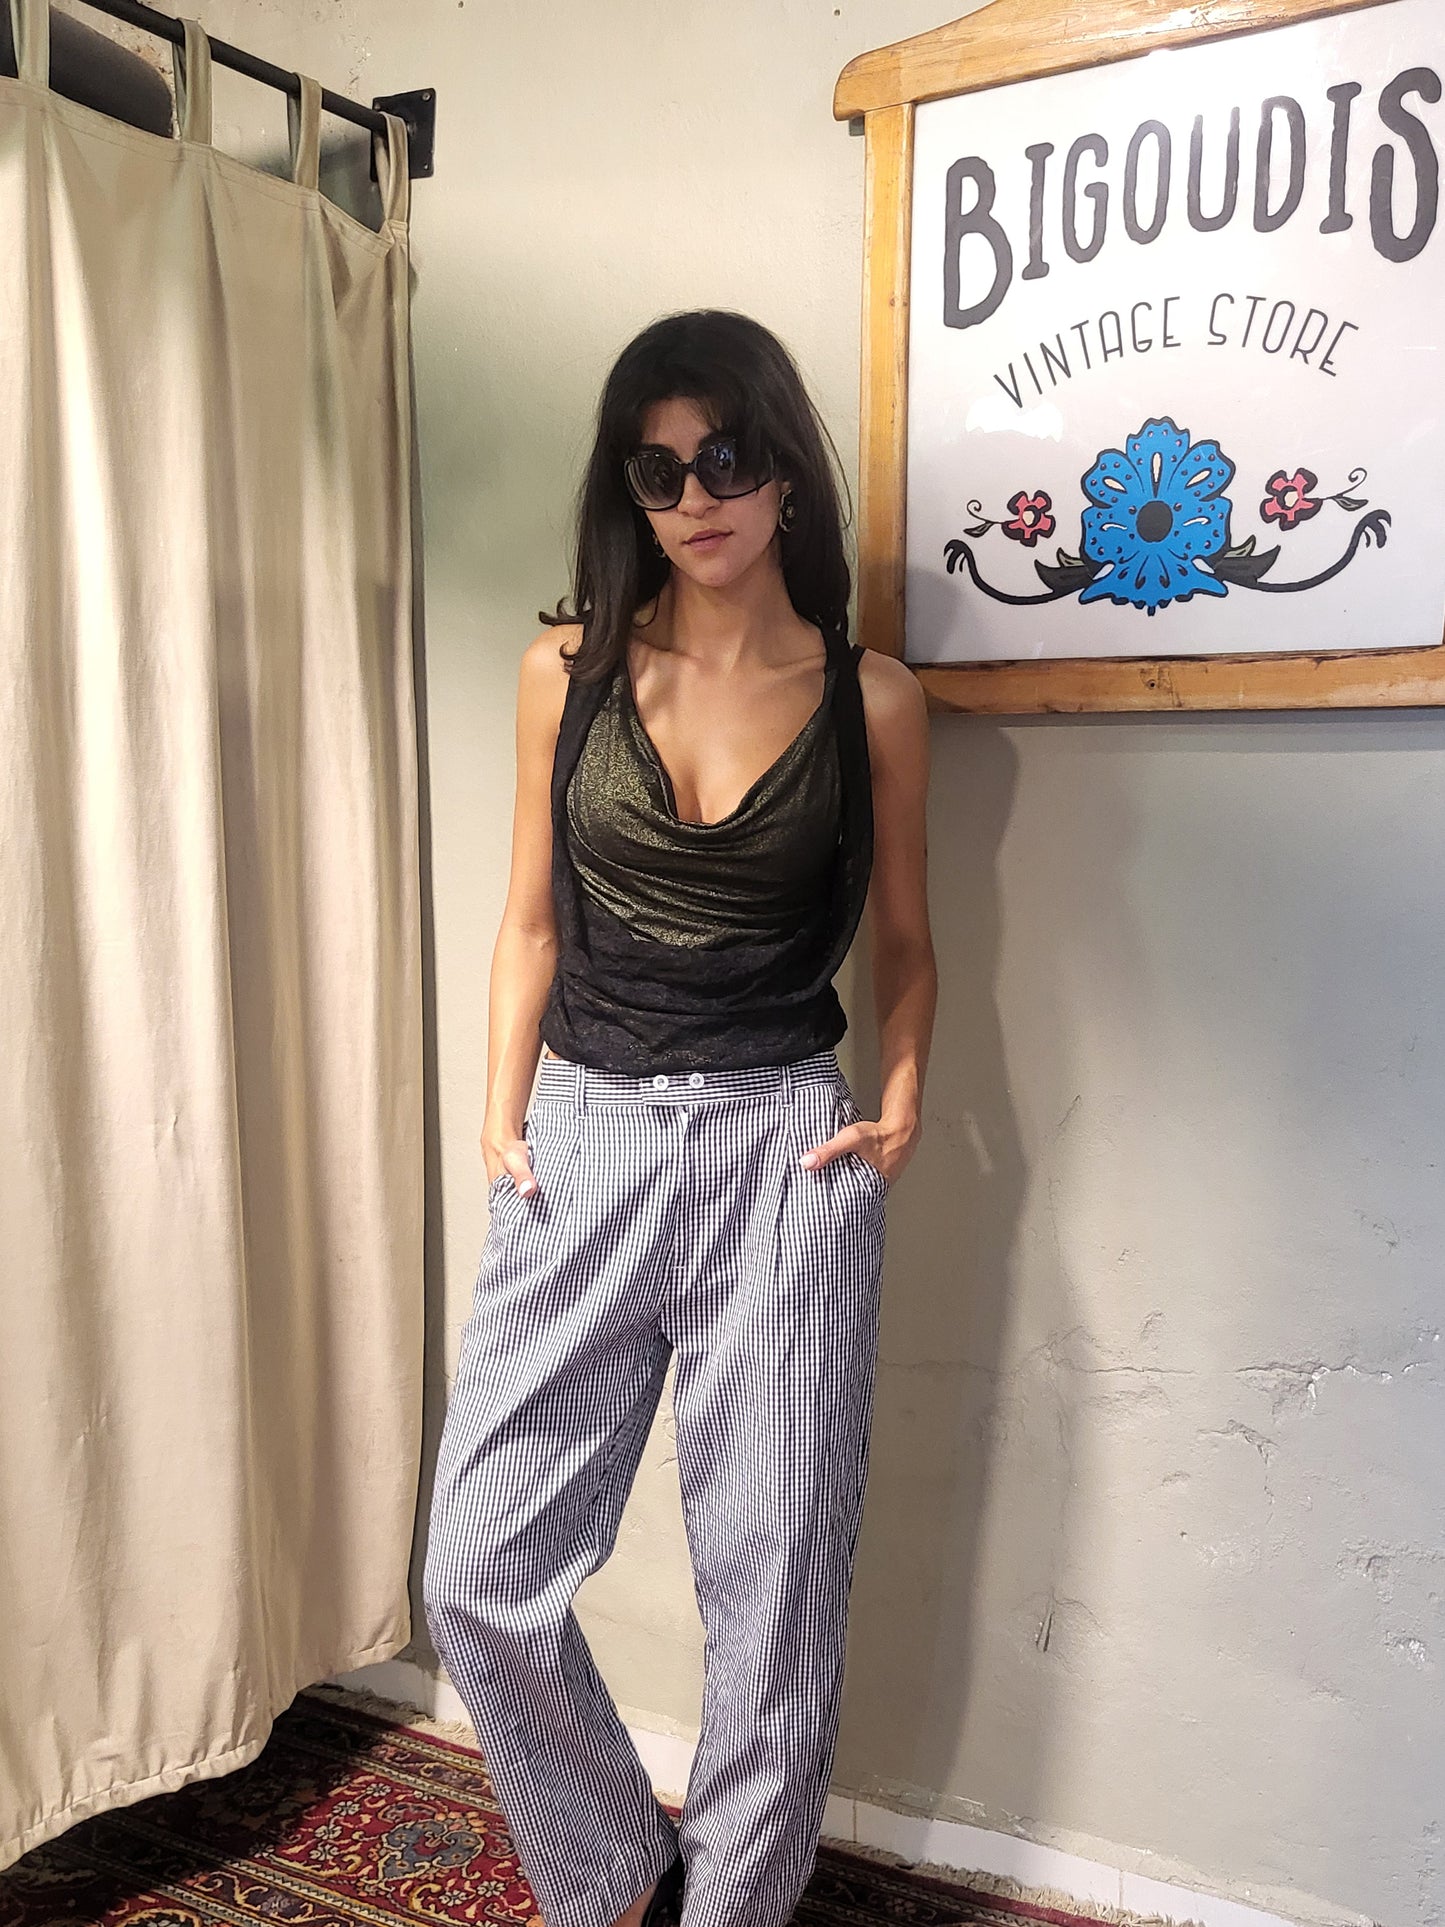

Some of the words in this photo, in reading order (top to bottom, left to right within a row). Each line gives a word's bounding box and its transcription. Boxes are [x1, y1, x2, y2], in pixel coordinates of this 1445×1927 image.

[943, 67, 1442, 329] BIGOUDIS
[993, 296, 1182, 409] VINTAGE
[1207, 293, 1359, 377] STORE
